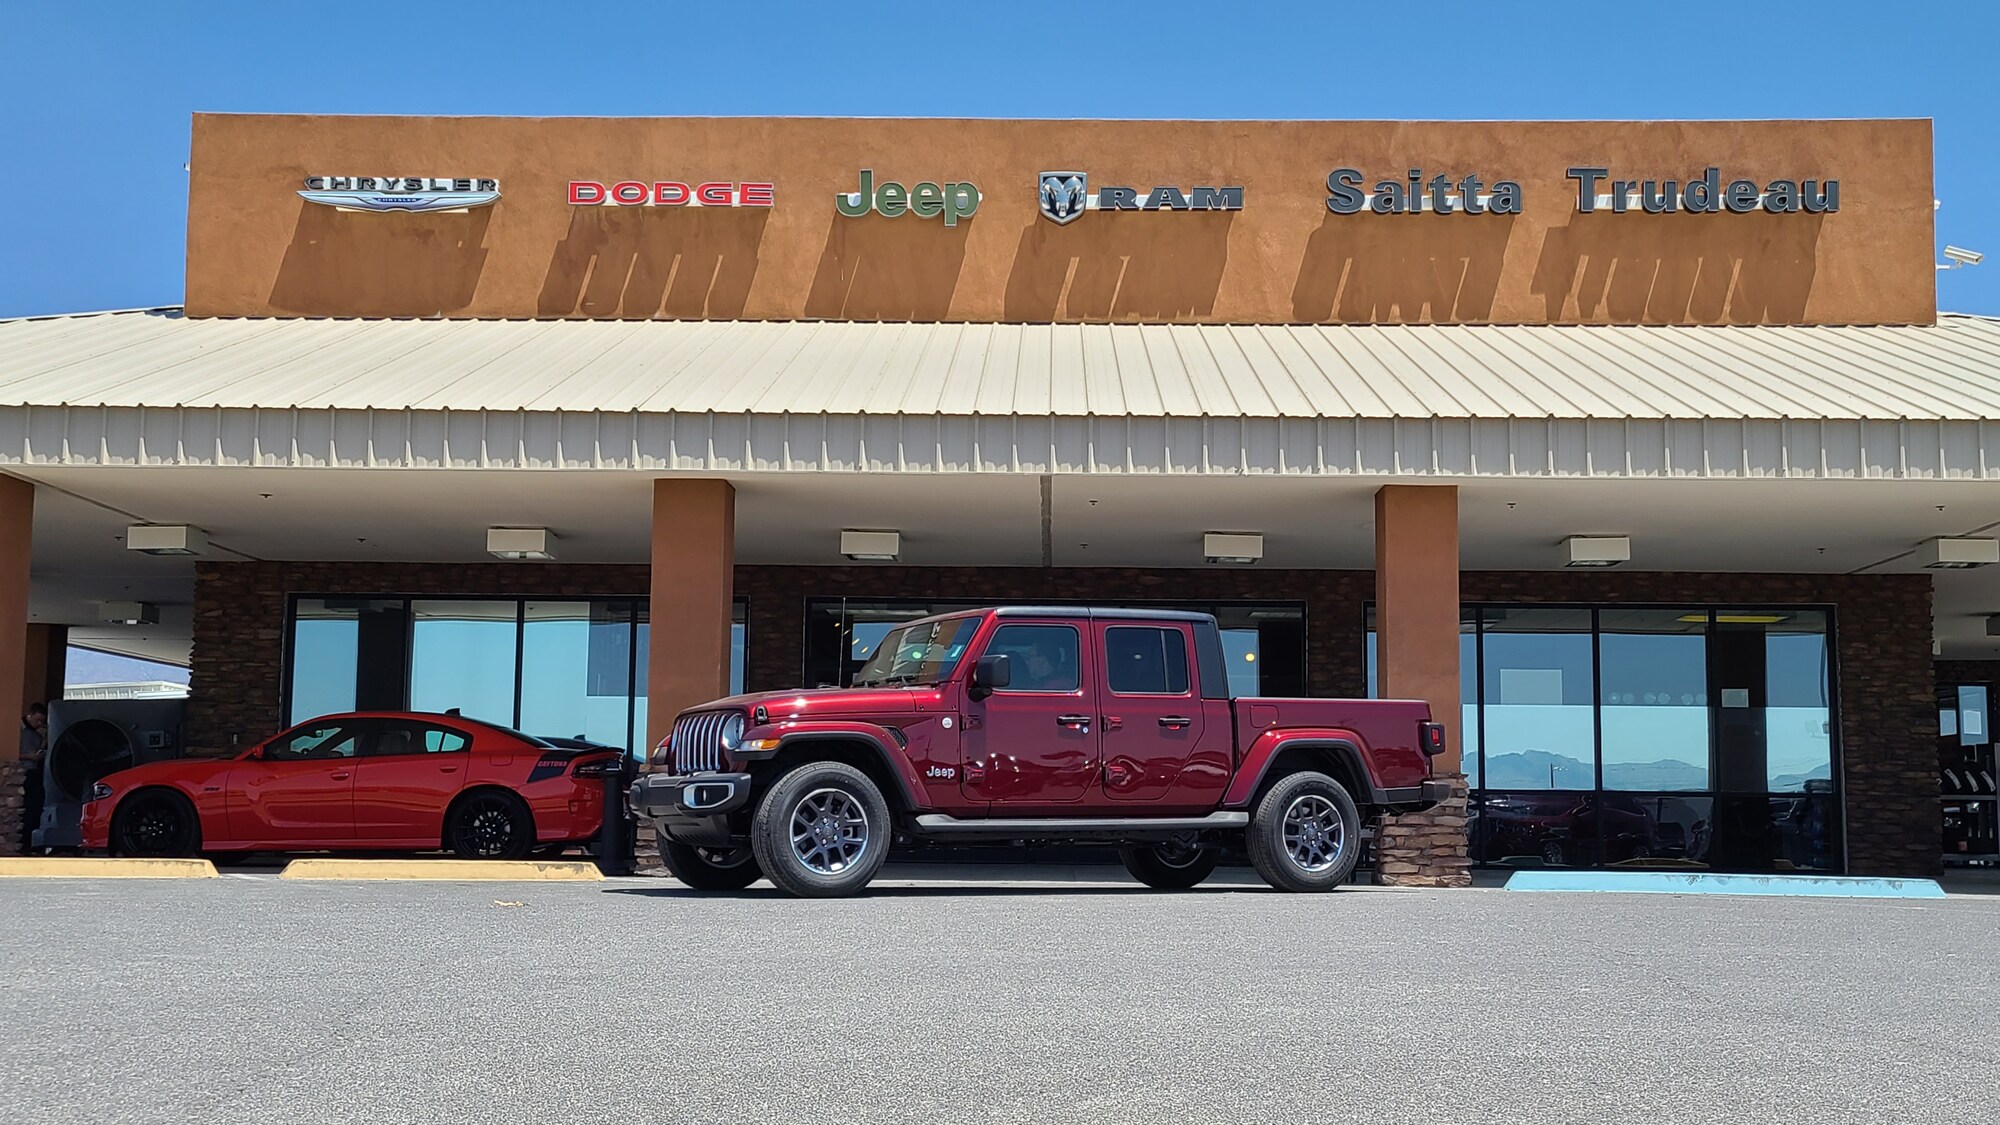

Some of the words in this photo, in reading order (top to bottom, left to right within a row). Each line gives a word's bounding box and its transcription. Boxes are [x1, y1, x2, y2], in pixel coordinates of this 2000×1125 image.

[304, 176, 498, 192] CHRYSLER
[567, 180, 774, 207] DODGE
[1326, 168, 1522, 214] Saitta
[1566, 167, 1840, 213] Trudeau
[835, 169, 981, 227] Jeep
[1098, 186, 1244, 210] RAM
[926, 765, 955, 779] Jeep
